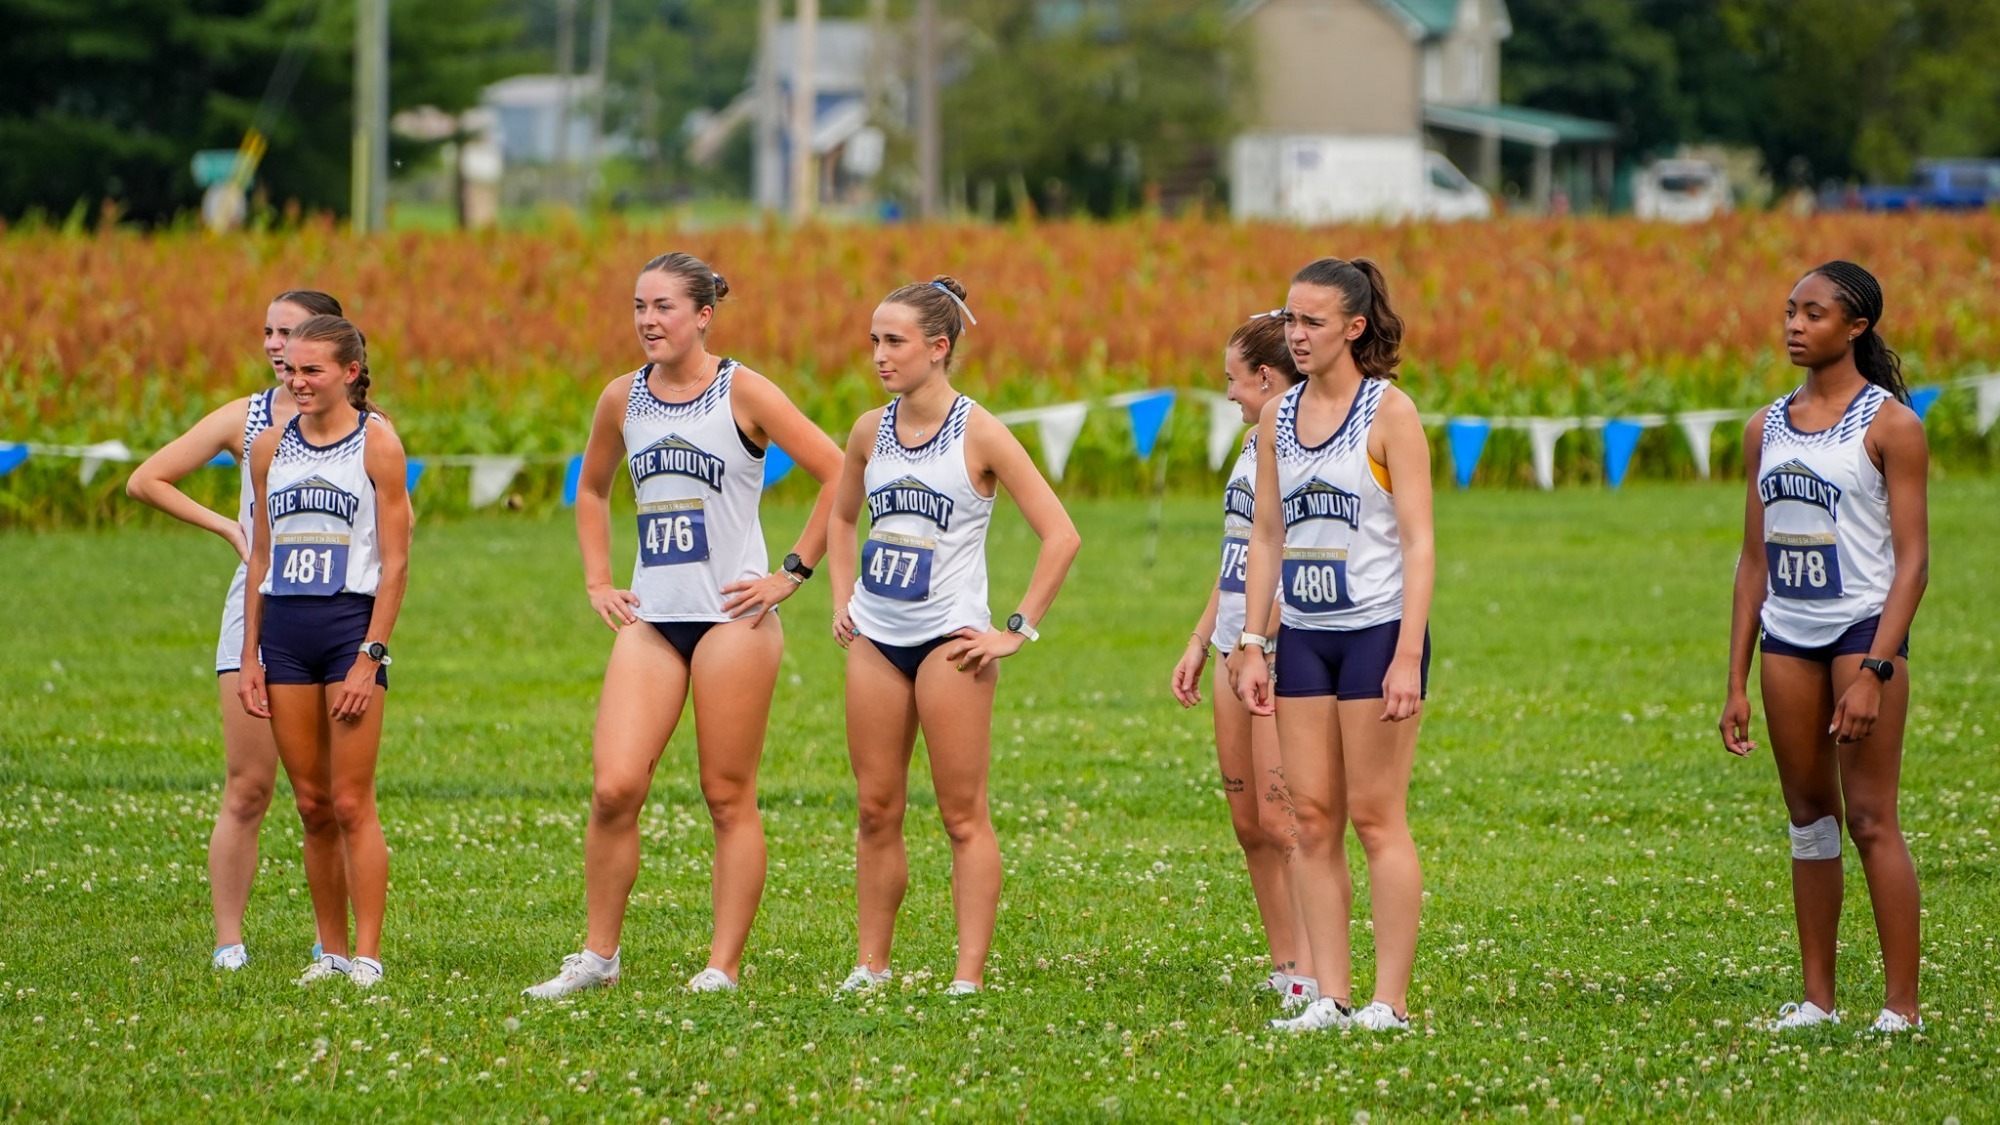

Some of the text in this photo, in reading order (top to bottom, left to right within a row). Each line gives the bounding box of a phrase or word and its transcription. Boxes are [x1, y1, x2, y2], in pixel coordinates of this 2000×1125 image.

[630, 449, 722, 488] THE MOUNT
[300, 488, 357, 523] MOUNT
[895, 489, 951, 527] MOUNT
[1305, 492, 1360, 526] MOUNT
[1780, 473, 1838, 517] MOUNT
[645, 515, 694, 555] 476
[282, 548, 333, 584] 481
[869, 547, 919, 588] 477
[1292, 564, 1337, 604] 480
[1777, 549, 1827, 588] 478
